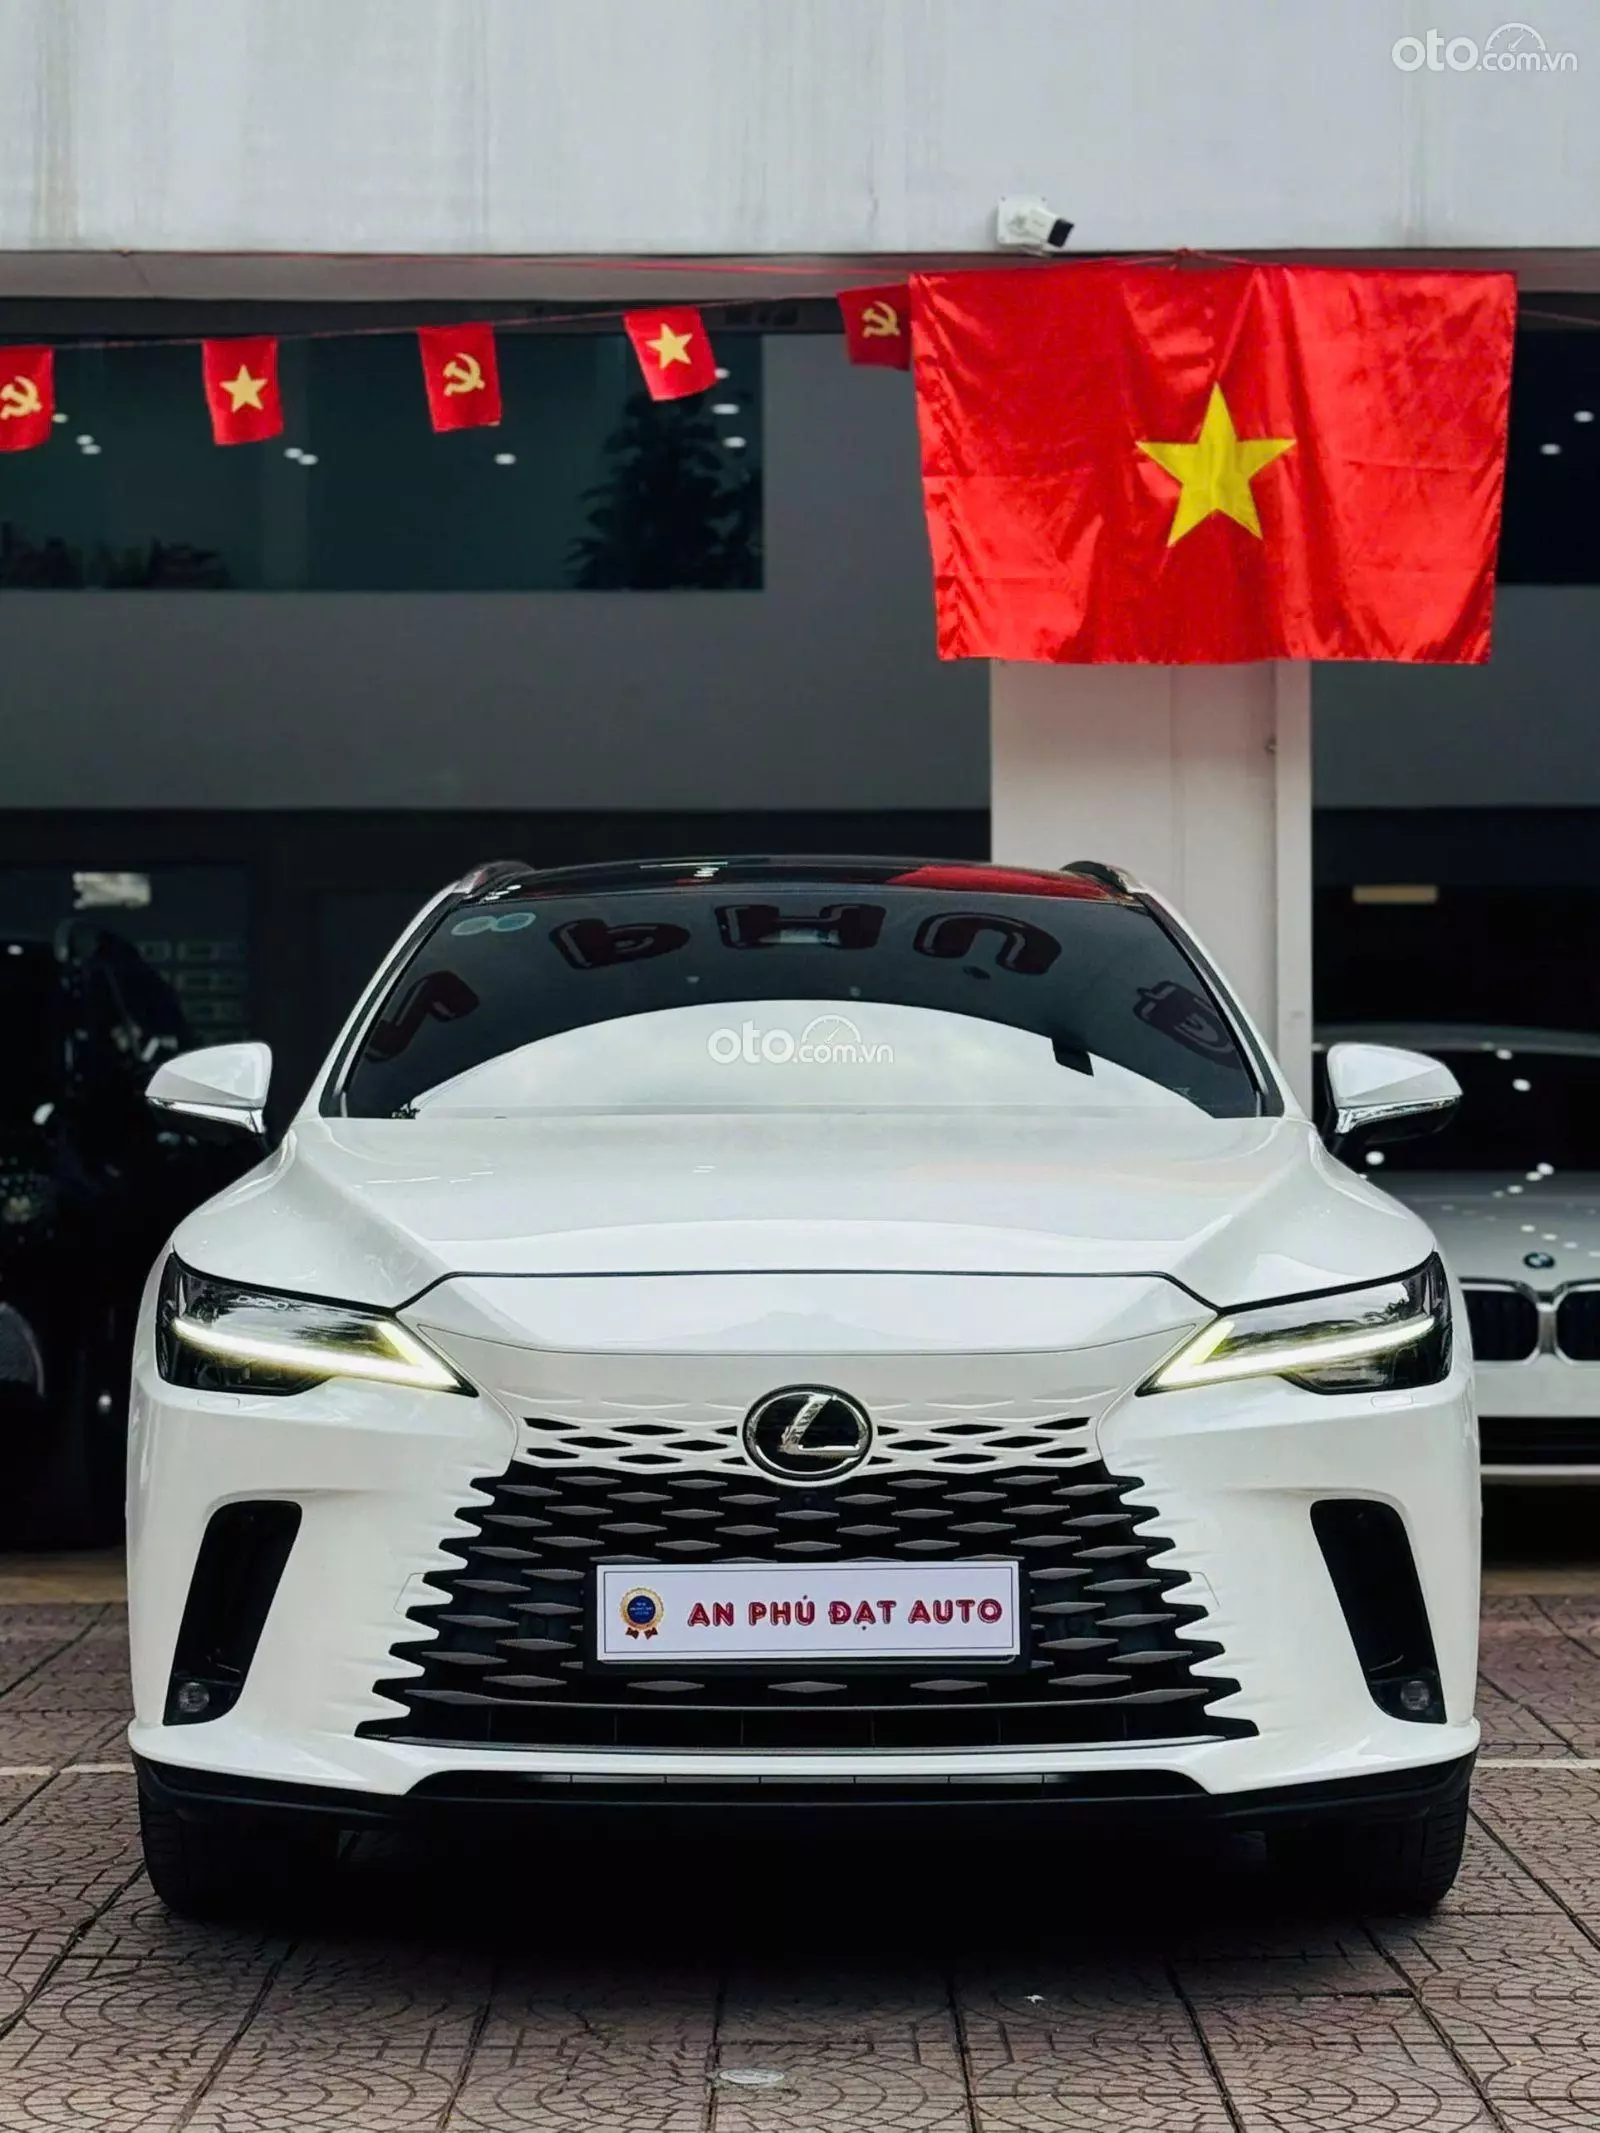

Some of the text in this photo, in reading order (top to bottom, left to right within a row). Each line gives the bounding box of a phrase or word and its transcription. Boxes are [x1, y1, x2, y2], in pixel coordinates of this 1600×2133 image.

[687, 1602, 735, 1627] AN
[828, 1600, 897, 1631] ĐẠT
[907, 1598, 1003, 1624] AUTO
